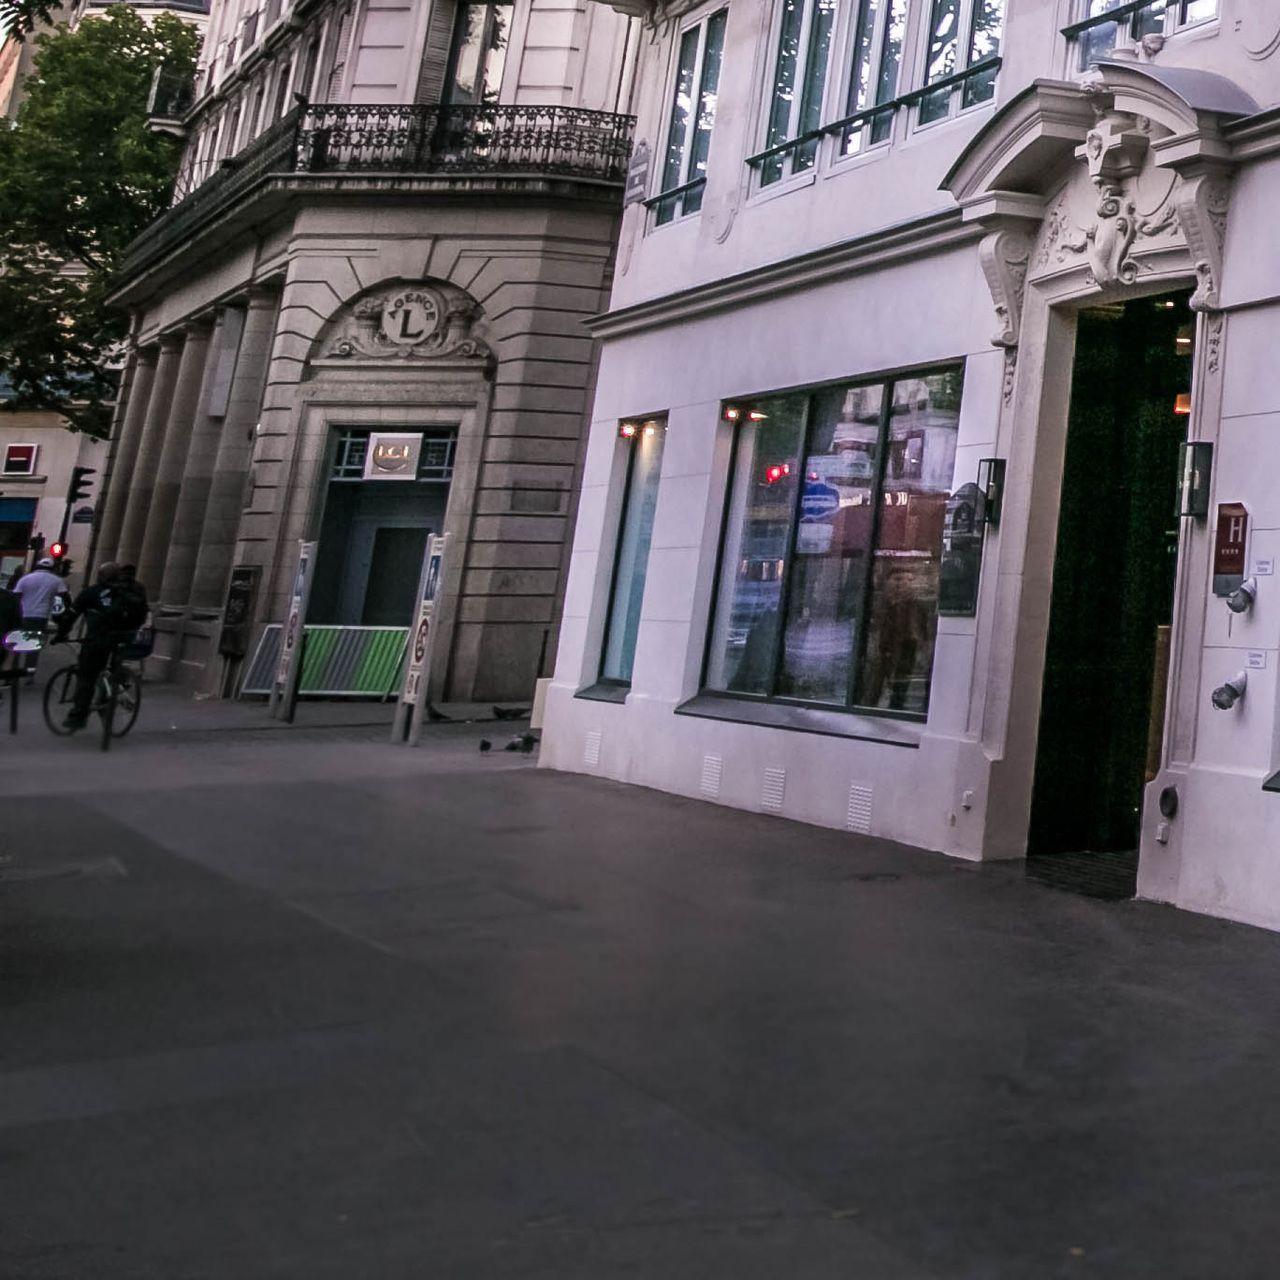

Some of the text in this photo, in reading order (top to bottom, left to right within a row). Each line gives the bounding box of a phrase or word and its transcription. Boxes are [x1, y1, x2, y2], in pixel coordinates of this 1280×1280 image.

[388, 293, 436, 321] AGENCE
[399, 309, 425, 339] L
[1229, 517, 1244, 544] H
